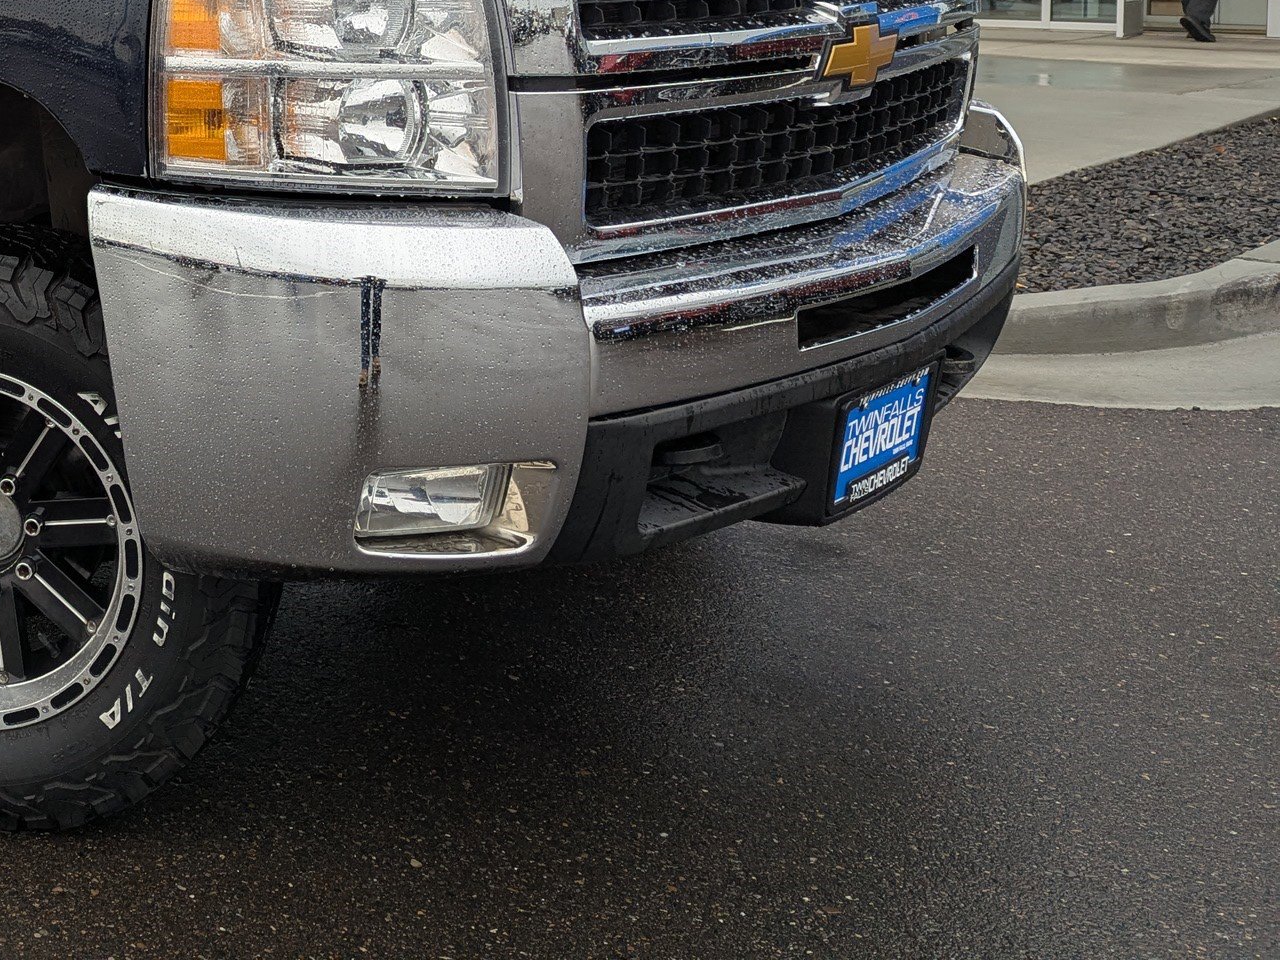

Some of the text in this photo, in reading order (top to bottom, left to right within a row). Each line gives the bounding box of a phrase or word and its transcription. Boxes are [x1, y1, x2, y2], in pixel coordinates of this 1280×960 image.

[840, 406, 920, 473] CHEVROLET
[868, 456, 910, 493] CHEVROLET
[98, 668, 154, 730] T/A
